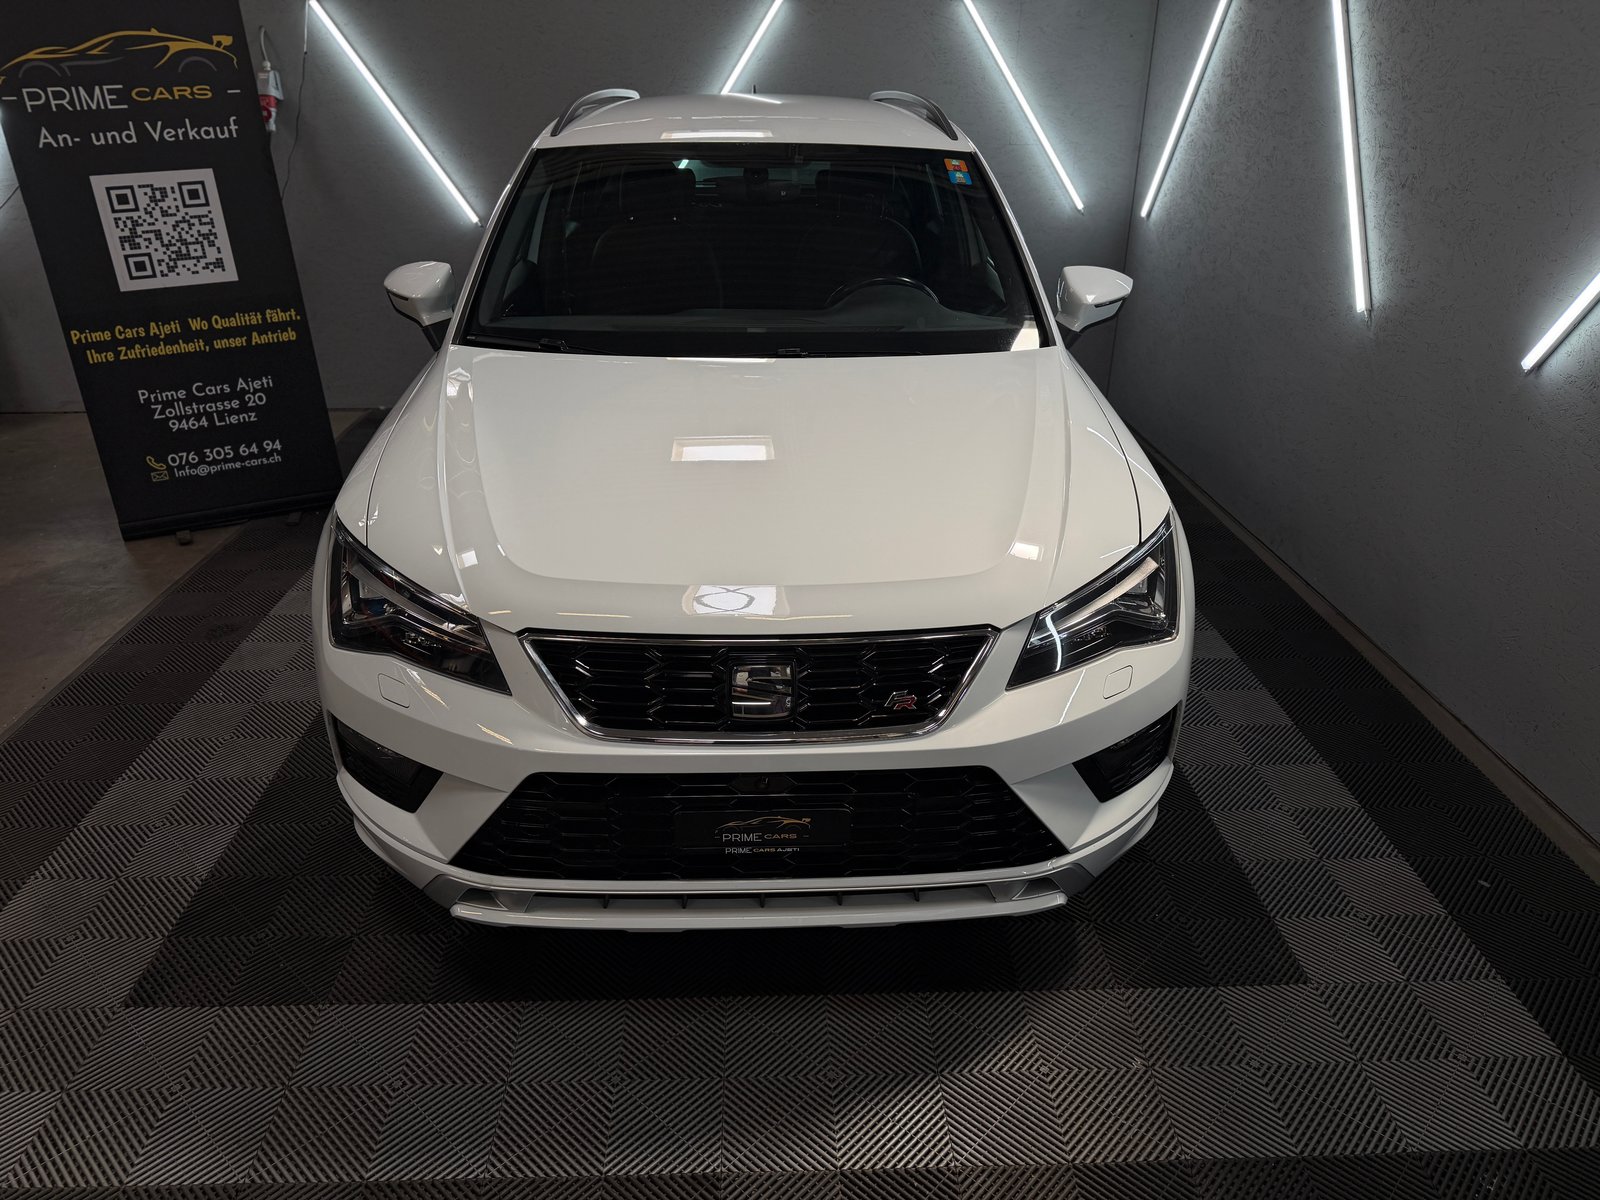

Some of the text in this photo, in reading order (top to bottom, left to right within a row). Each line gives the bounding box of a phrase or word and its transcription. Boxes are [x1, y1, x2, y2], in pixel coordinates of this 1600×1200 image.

[21, 84, 213, 113] PRIME CARS
[38, 116, 239, 149] An- und Verkauf
[70, 308, 301, 345] Prime Cars Ajeti Wo Qualität fährt.
[86, 327, 297, 364] Ihre Zufriedenheit, unser Antrieb
[137, 375, 274, 404] Prime Cars Ajeti
[150, 392, 267, 420] Zollstrasse 20
[168, 411, 258, 432] 9464 Lienz
[167, 439, 282, 467] 076 305 64 94
[174, 452, 283, 478] Info@prime-cars.ch
[722, 832, 763, 843] PRIME
[725, 847, 753, 855] PRIME
